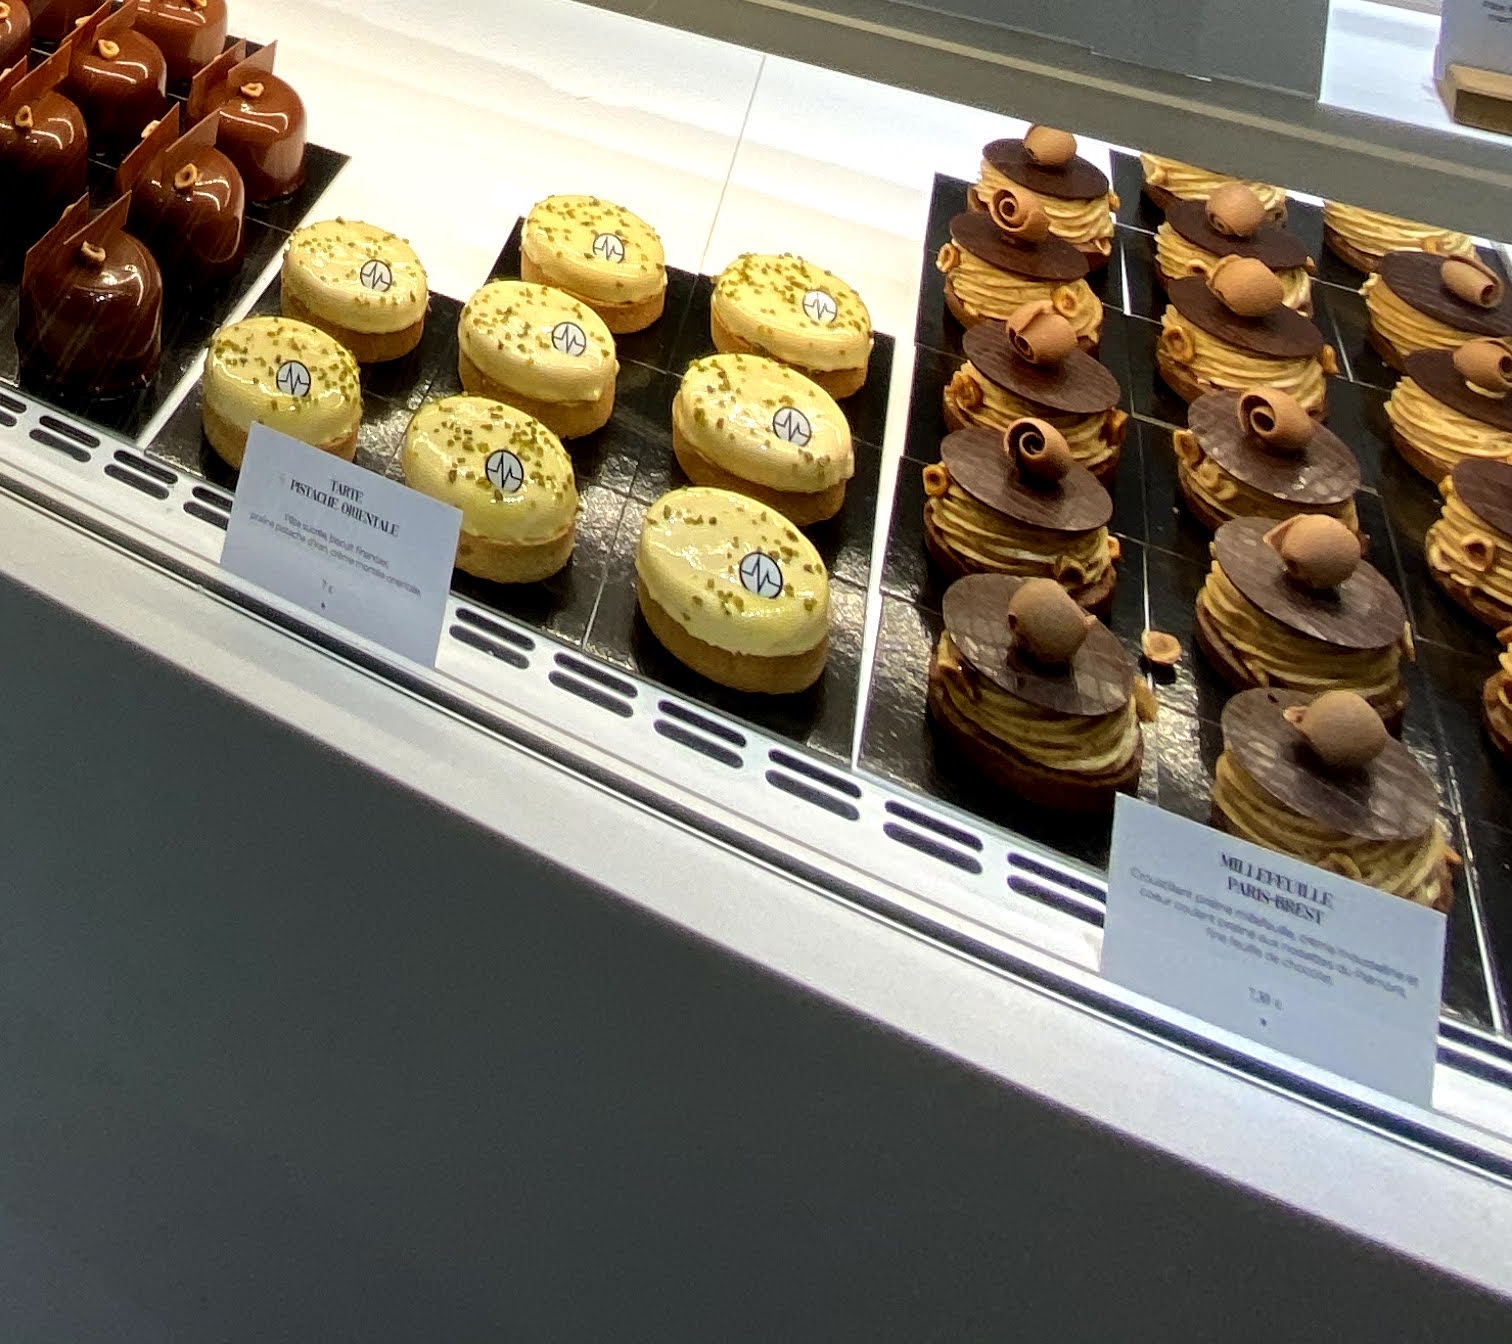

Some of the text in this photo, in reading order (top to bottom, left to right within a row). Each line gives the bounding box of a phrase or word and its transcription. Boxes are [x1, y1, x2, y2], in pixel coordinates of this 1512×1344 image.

[289, 478, 400, 538] PISTACHE ORIENTALE
[330, 478, 364, 504] TARTE
[1227, 874, 1326, 926] PARIS-BREST
